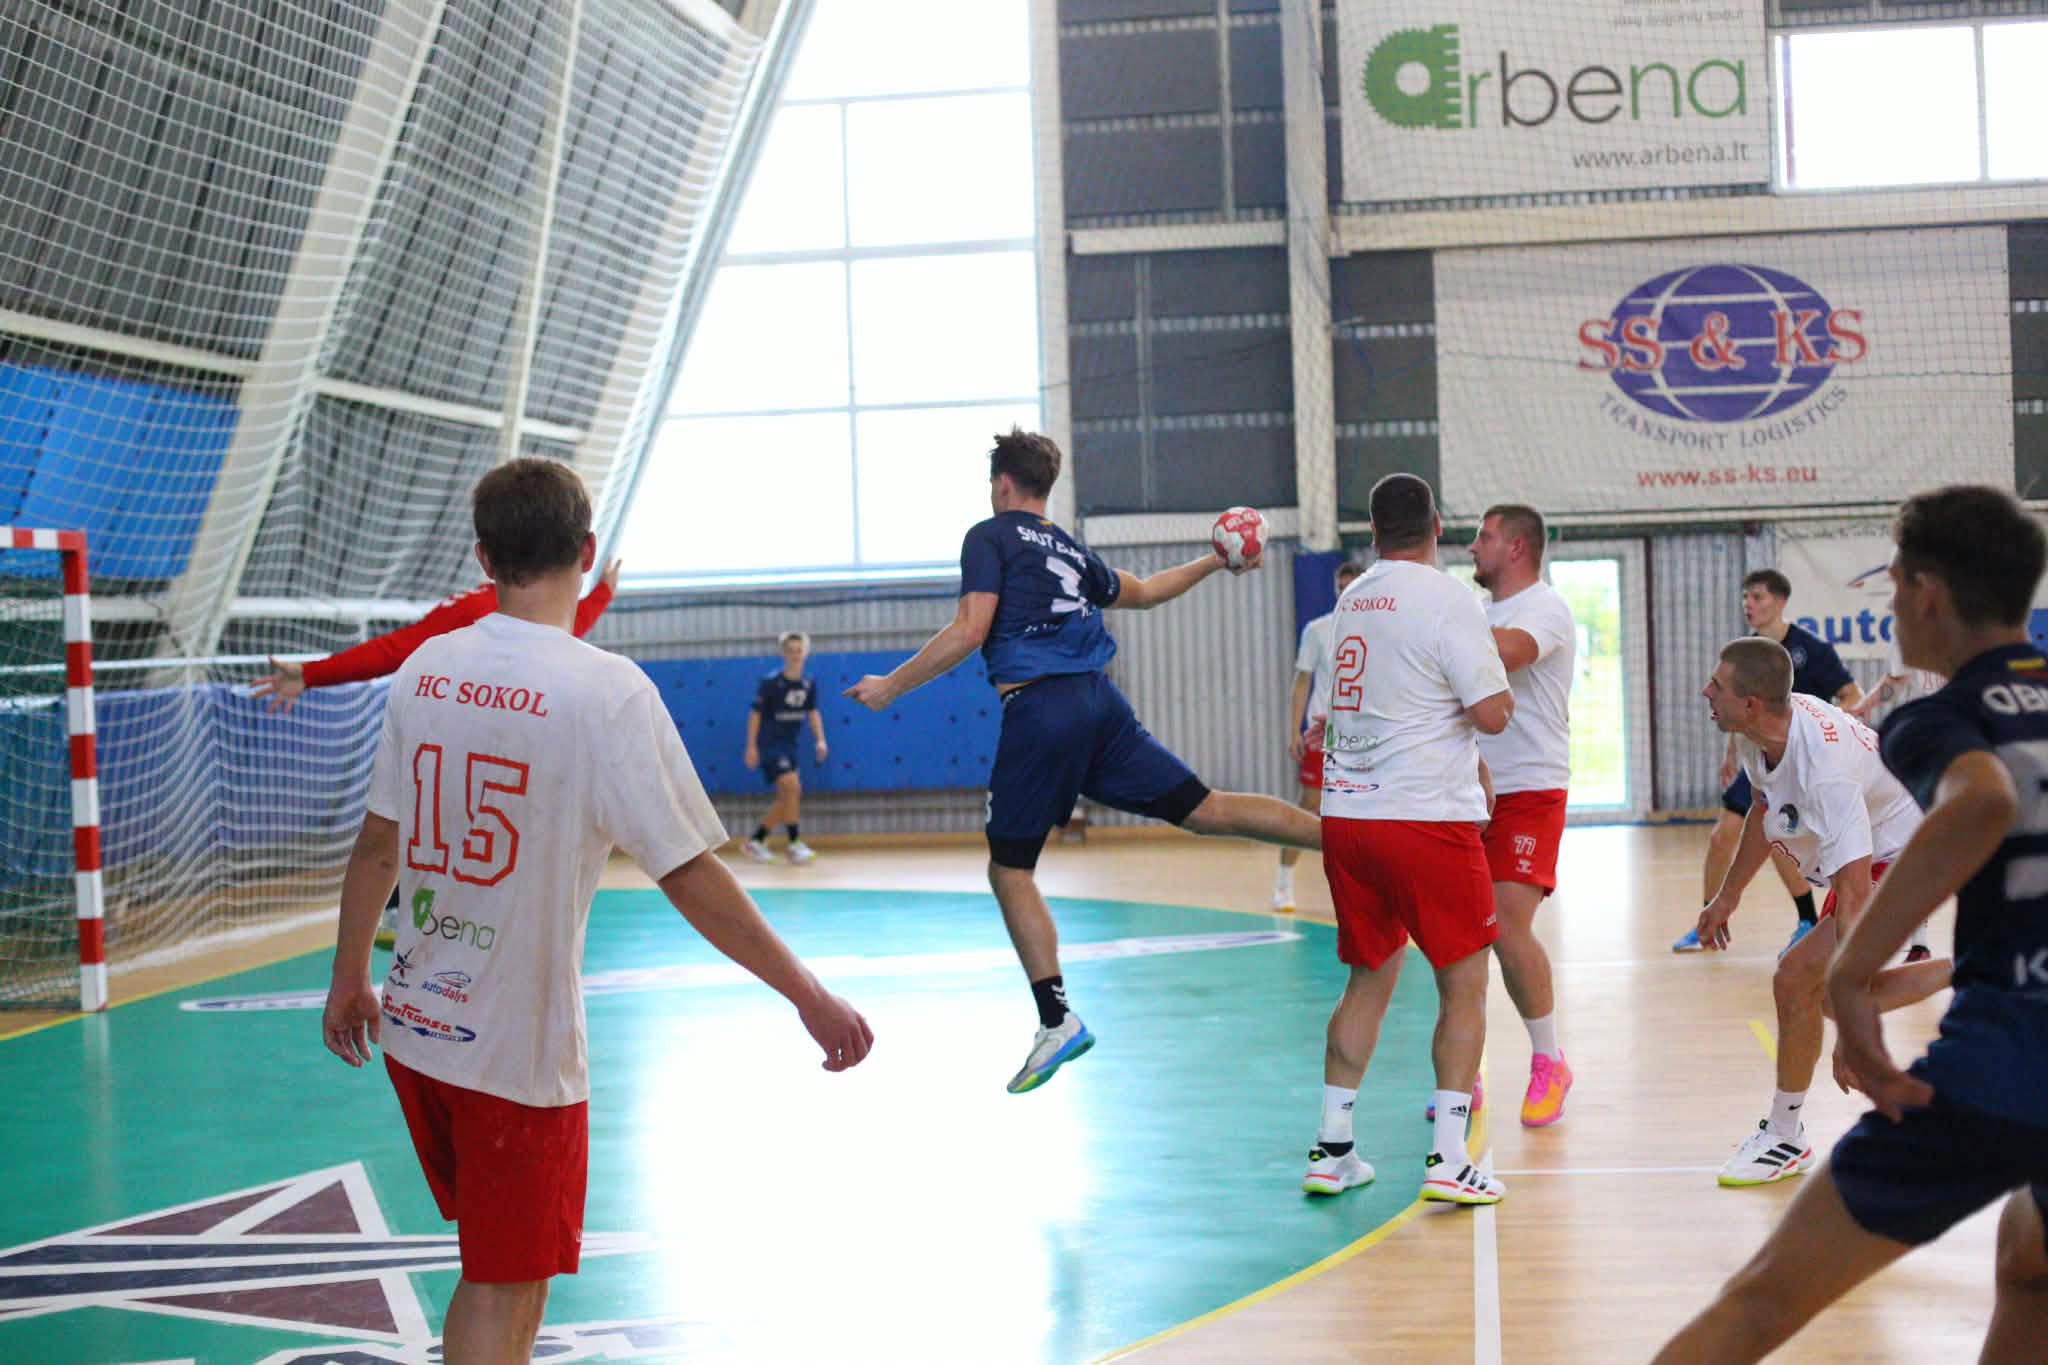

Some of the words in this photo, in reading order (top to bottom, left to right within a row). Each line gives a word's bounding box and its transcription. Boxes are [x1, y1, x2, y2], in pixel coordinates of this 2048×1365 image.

[1363, 23, 1747, 128] arbena
[1573, 142, 1750, 169] www.arbena.lt
[1576, 316, 1665, 374] SS
[1689, 311, 1746, 370] &
[1770, 308, 1868, 368] KS
[1601, 392, 1730, 450] TRANSPORT
[1740, 384, 1848, 448] LOGISTICS
[1636, 464, 1818, 487] www.ss-ks.eu
[1352, 597, 1397, 612] SOKOL
[415, 675, 450, 701] HC
[455, 681, 549, 717] SOKOL
[1331, 636, 1368, 712] 2
[407, 743, 530, 887] 15
